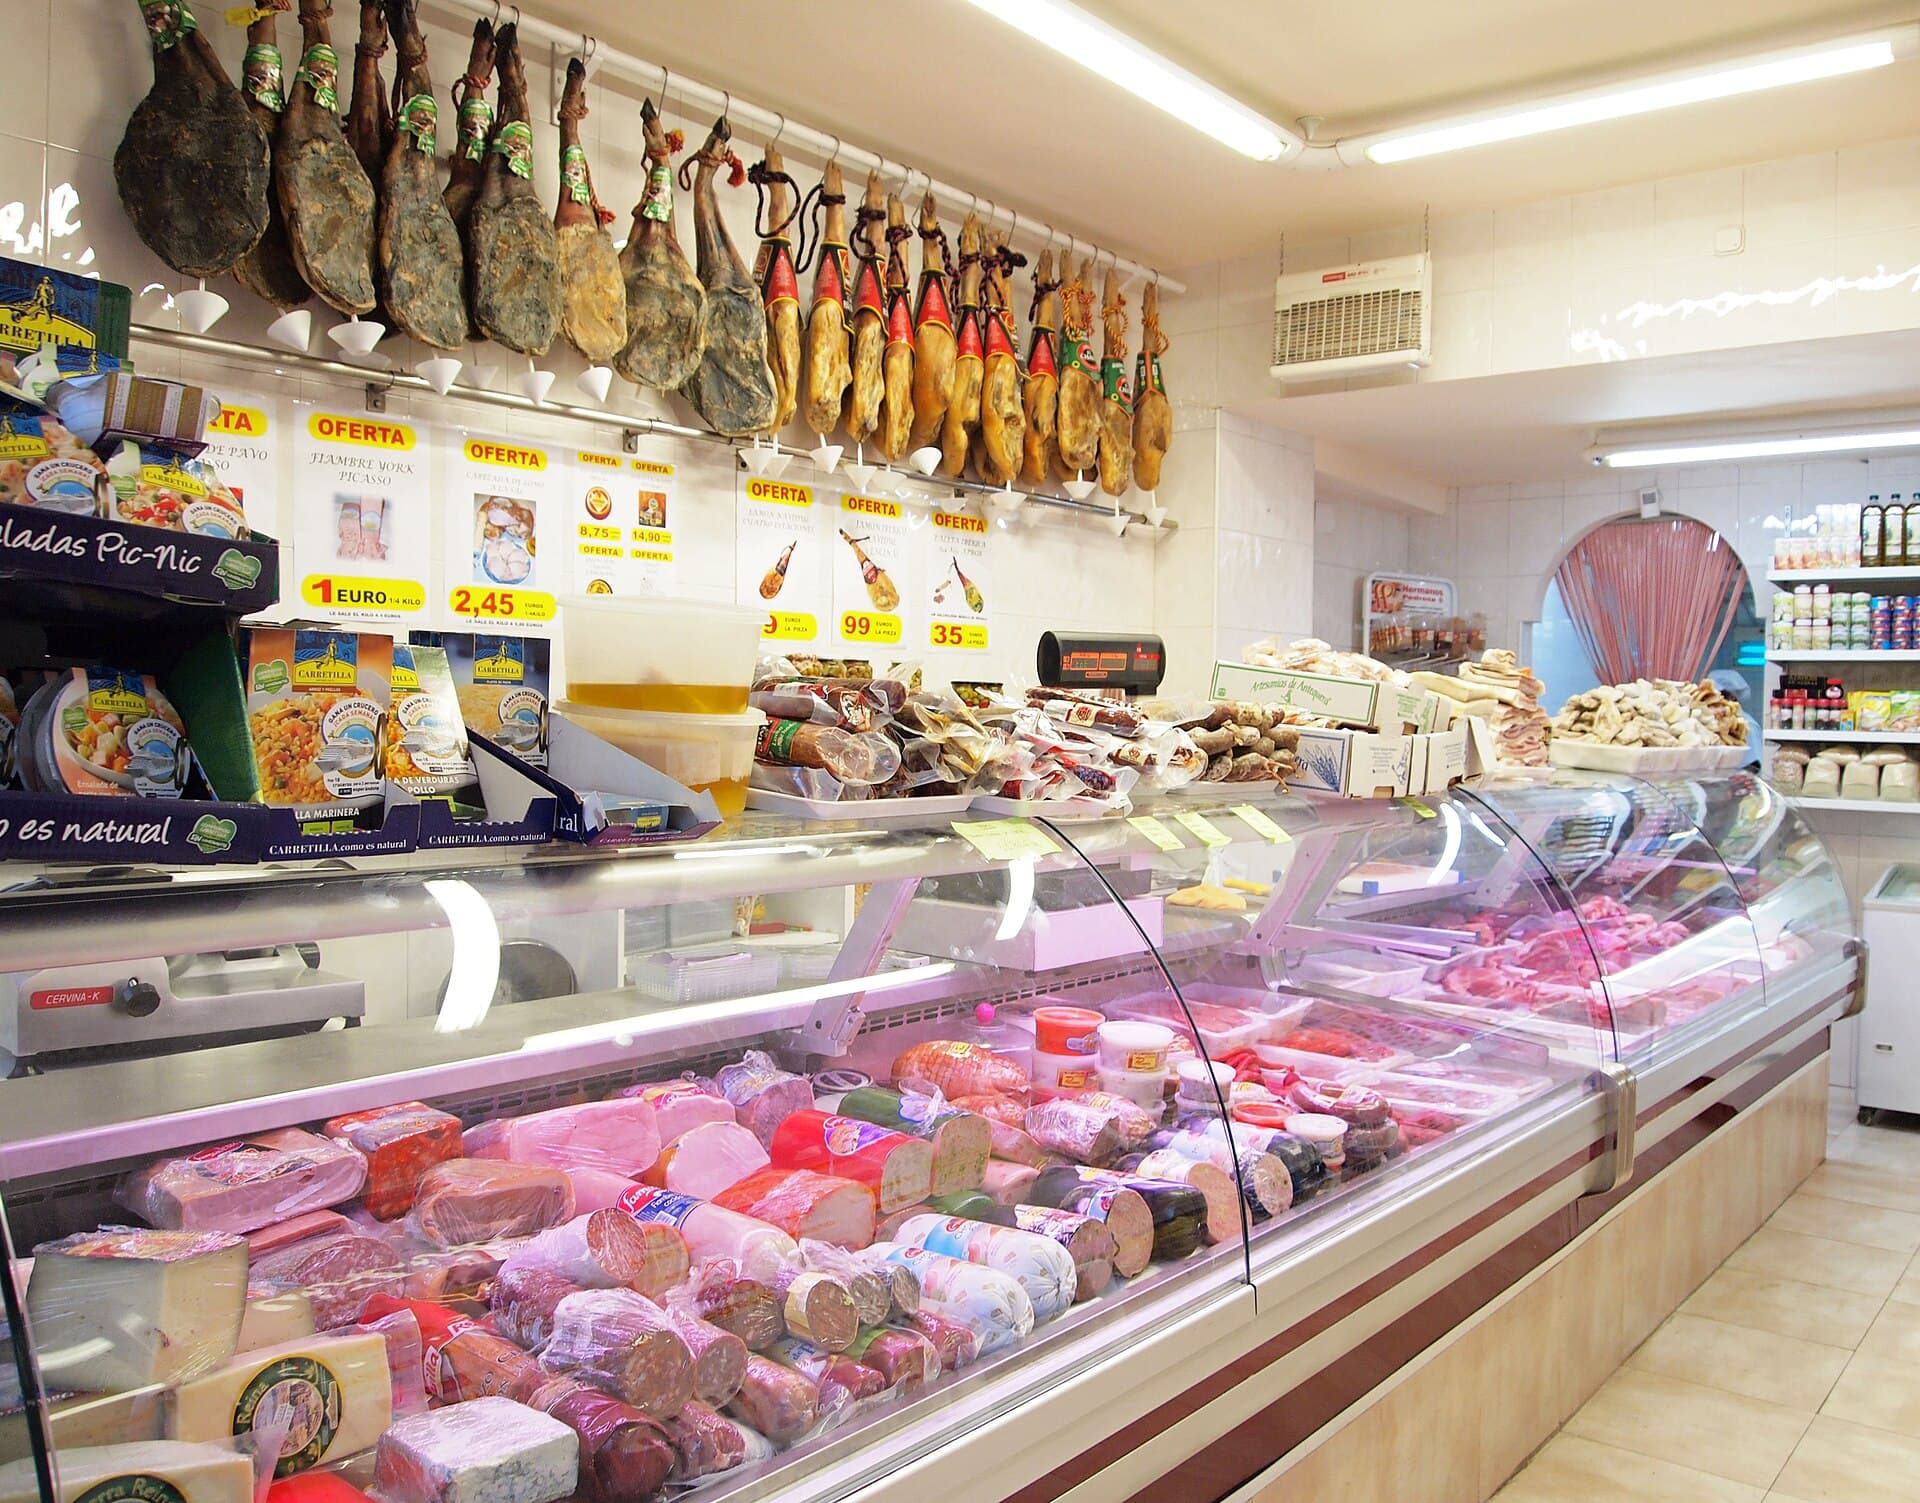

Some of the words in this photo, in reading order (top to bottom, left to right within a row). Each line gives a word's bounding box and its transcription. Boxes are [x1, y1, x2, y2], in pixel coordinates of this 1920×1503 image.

[318, 418, 405, 446] OFERTA
[229, 446, 268, 460] PAVO
[470, 443, 540, 467] OFERTA
[582, 454, 617, 466] OFERTA
[309, 452, 374, 470] FIAMBRE
[378, 459, 415, 474] YORK
[636, 462, 669, 474] OFERTA
[145, 471, 201, 491] CARRETILLA
[338, 470, 392, 486] PICASSO
[751, 482, 807, 503] OFERTA
[848, 497, 896, 517] OFERTA
[935, 513, 985, 533] OFERTA
[580, 526, 609, 538] 8,75
[633, 530, 661, 543] 14,90
[96, 532, 202, 574] Pic-Nic
[583, 546, 619, 556] OFERTA
[635, 550, 669, 560] OFERTA
[312, 579, 332, 603] 1
[337, 589, 387, 604] EURO
[454, 589, 514, 618] 2,45
[844, 615, 870, 635] 99
[933, 624, 963, 645] 35
[298, 670, 352, 680] CARRETILLA
[478, 666, 520, 675] CARRETILLA
[94, 698, 143, 709] CARRETILLA
[329, 707, 343, 723] GANA
[343, 702, 353, 711] UN
[353, 702, 379, 716] CRUCERO
[402, 777, 415, 785] DE
[415, 777, 460, 785] VERDURAS
[407, 786, 436, 794] POLLO
[313, 807, 360, 818] MARINERA
[18, 819, 56, 841] es
[62, 816, 172, 845] natural
[511, 834, 519, 842] es
[520, 832, 546, 841] natural
[377, 840, 407, 849] natural
[46, 991, 101, 1005] CERVINA-K
